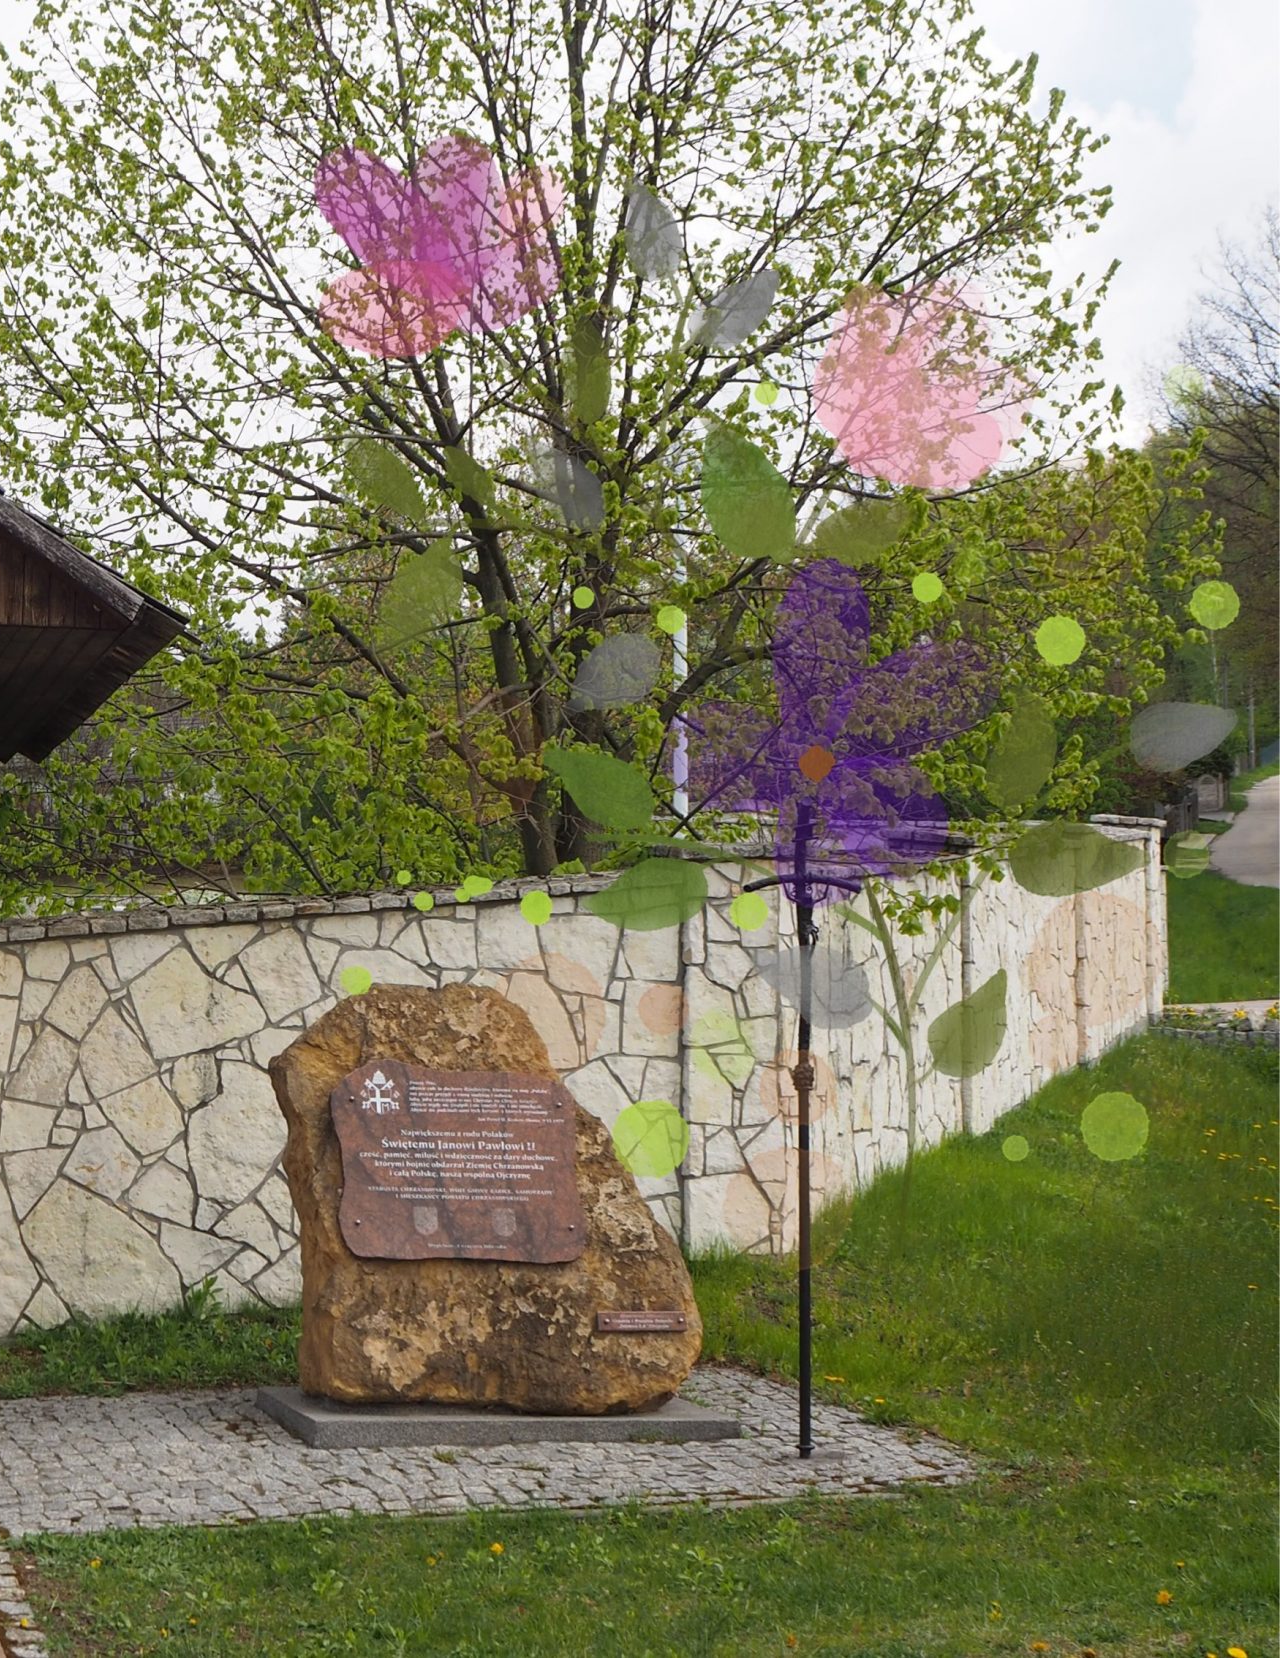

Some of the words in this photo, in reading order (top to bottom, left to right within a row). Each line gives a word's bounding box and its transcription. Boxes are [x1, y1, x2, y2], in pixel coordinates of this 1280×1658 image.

[381, 1136, 435, 1150] Świętemu
[438, 1140, 475, 1150] Janowi
[478, 1141, 525, 1151] Pawłowi
[526, 1142, 536, 1151] II
[503, 1153, 520, 1161] dary
